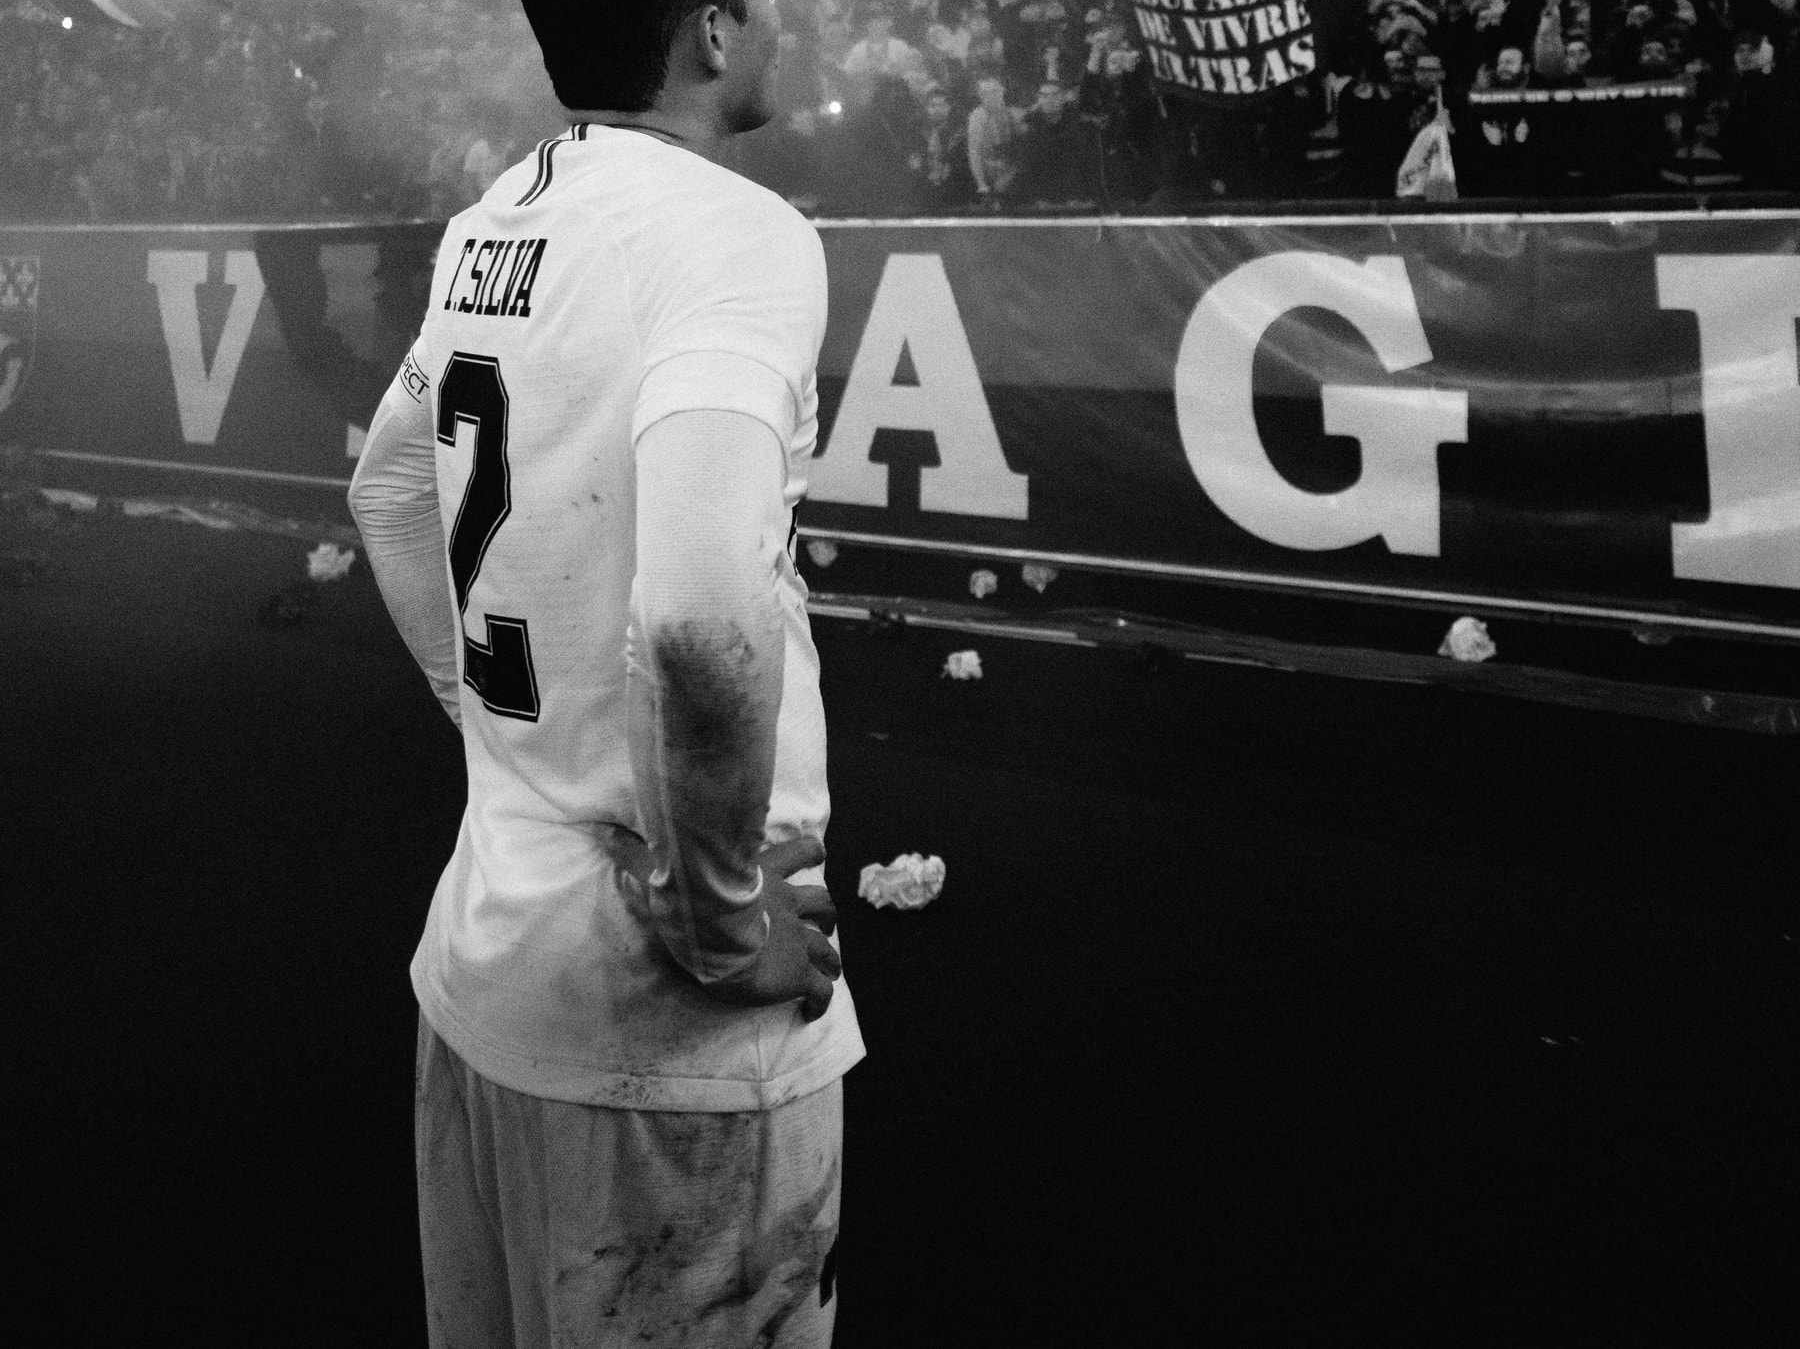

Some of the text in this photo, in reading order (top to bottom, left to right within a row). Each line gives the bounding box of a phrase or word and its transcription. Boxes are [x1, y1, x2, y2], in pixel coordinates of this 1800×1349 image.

[1134, 6, 1177, 45] DE
[1147, 33, 1316, 94] ULTRAS
[402, 354, 430, 395] PECT
[437, 350, 540, 723] 2
